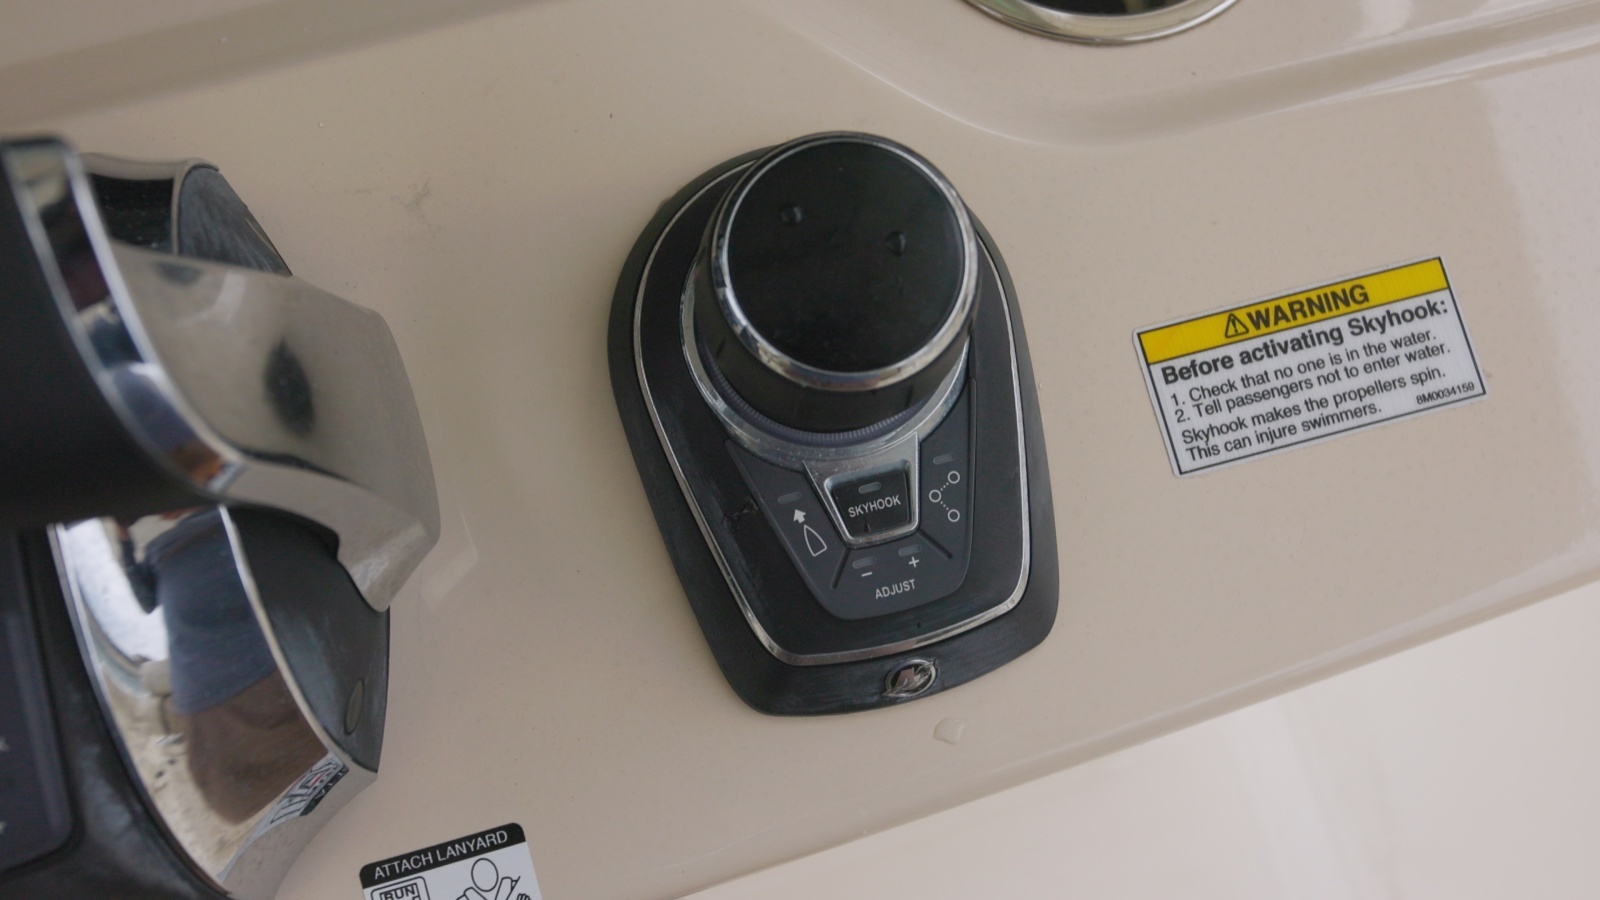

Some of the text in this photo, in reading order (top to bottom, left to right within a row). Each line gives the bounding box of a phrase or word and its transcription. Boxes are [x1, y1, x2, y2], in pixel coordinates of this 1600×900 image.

[1246, 284, 1370, 331] WARNING
[1161, 298, 1449, 385] Before activating Skyhook:
[1171, 328, 1437, 407] 1. Check that no one is in the water.
[1175, 341, 1451, 423] 2. Tell passengers not to enter water.
[1182, 369, 1447, 445] Skyhook makes the propellers spin.
[1186, 403, 1382, 462] This can injure swimmers.
[848, 495, 901, 518] SKYHOOK
[875, 579, 916, 599] ADJUST
[374, 830, 508, 880] ATTACH LANYARD
[384, 885, 415, 900] RUN
